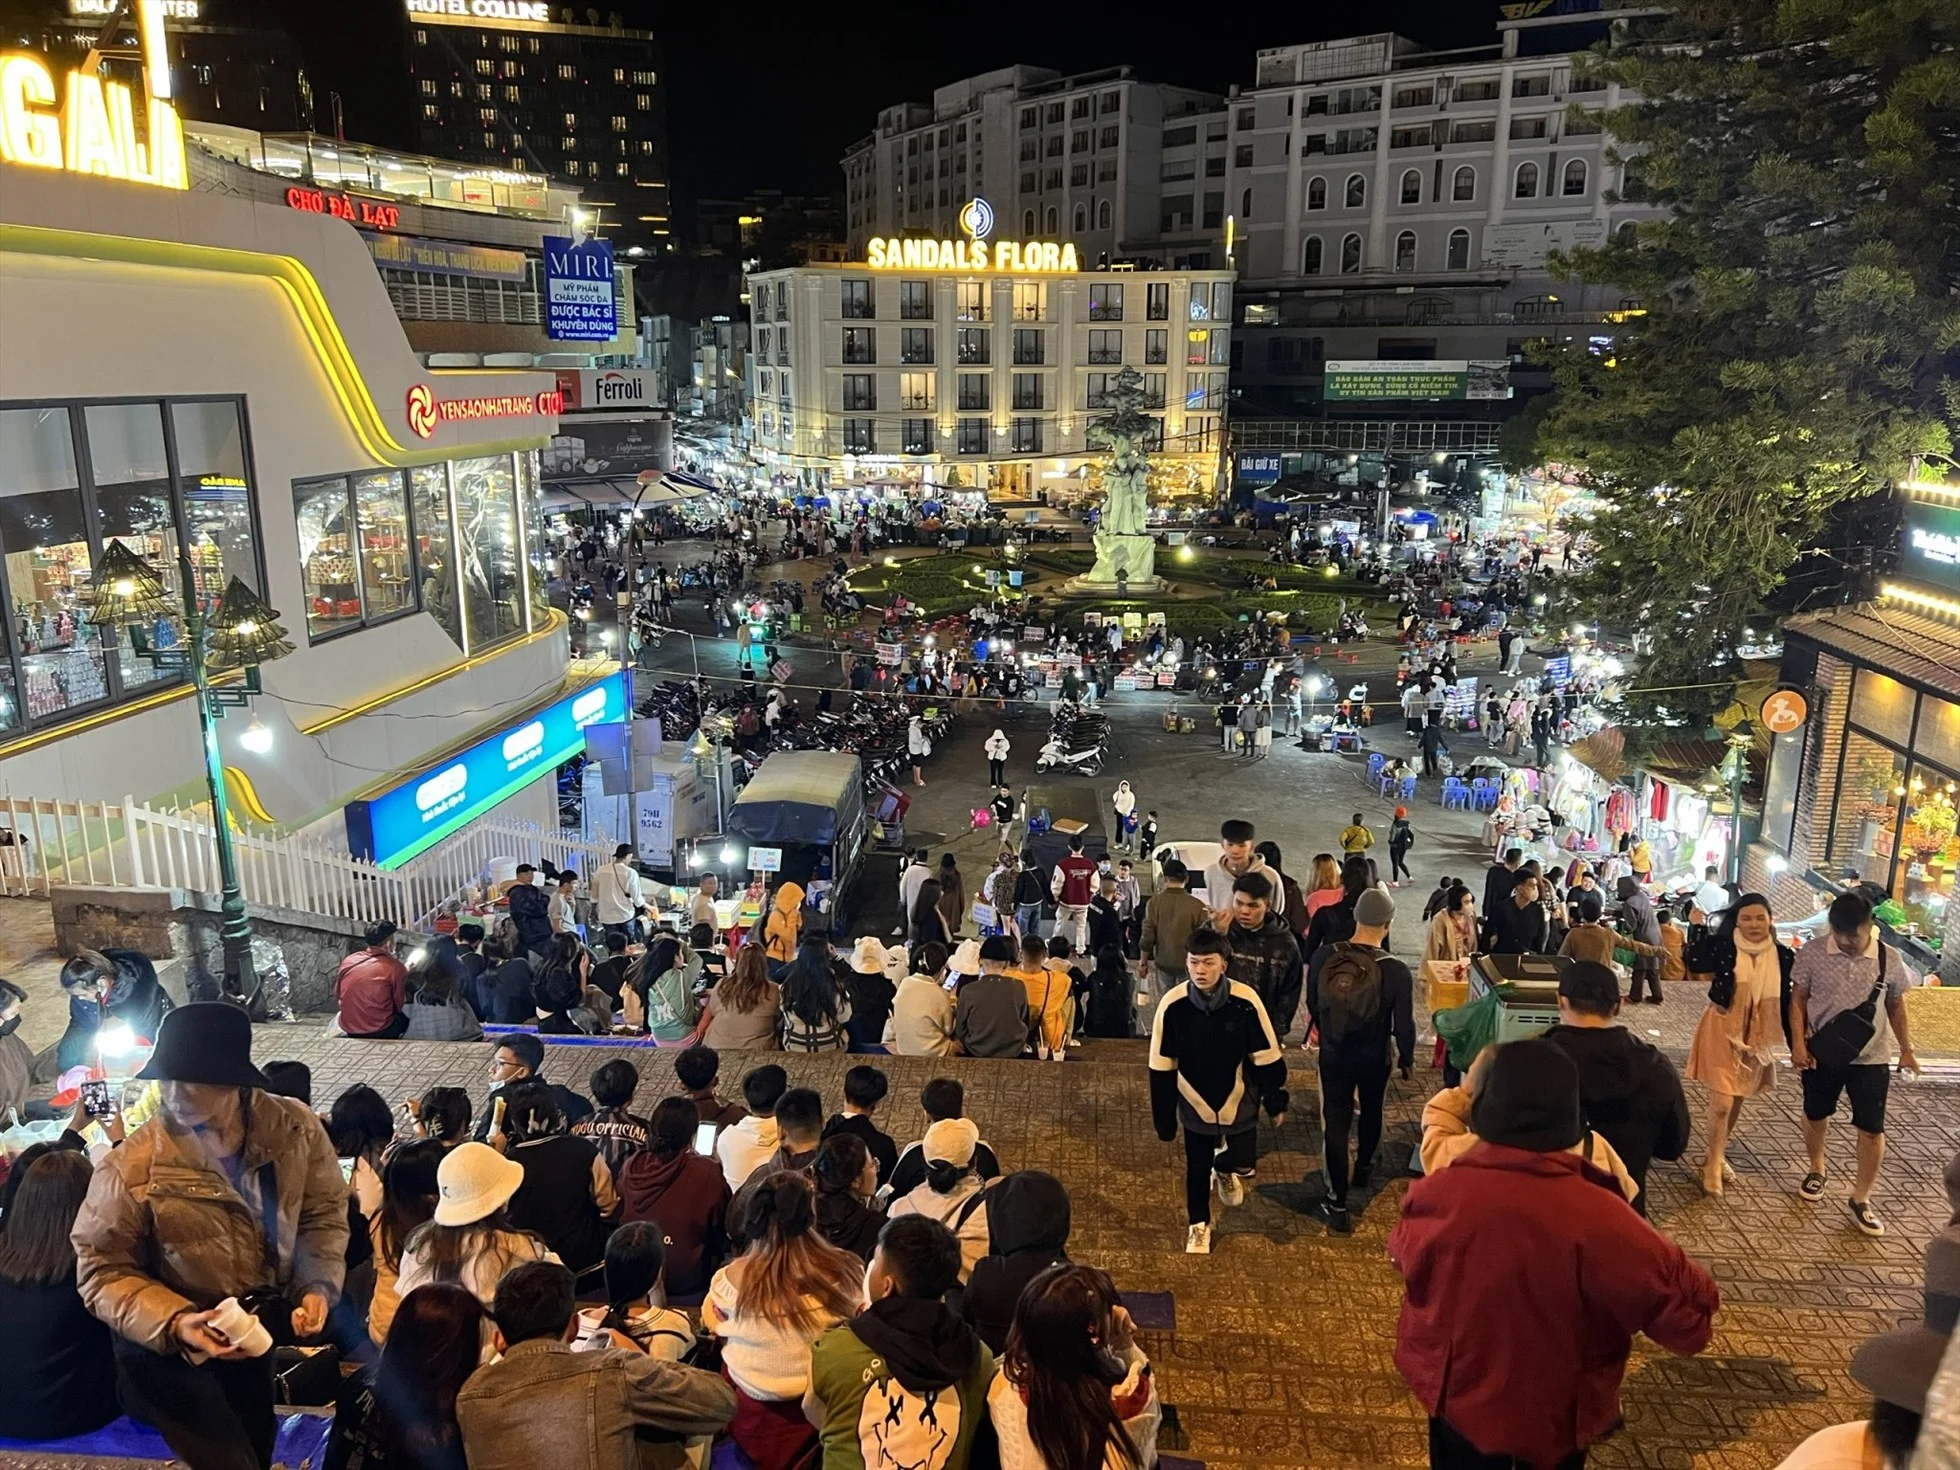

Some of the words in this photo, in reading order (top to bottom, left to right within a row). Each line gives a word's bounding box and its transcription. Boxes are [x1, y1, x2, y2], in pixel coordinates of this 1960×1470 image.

[407, 0, 469, 15] HOTEL
[472, 0, 549, 22] COLLINE
[328, 193, 357, 221] ĐÀ
[361, 202, 399, 231] LẠT
[550, 252, 609, 278] MIRI
[867, 237, 989, 269] SANDALS
[995, 240, 1079, 272] FLORA
[551, 305, 580, 319] ĐƯỢC
[582, 305, 601, 318] BÁC
[551, 318, 588, 330] KHUYÊN
[589, 319, 614, 331] DÙNG
[438, 396, 534, 421] YENSAONHATRANG
[1241, 456, 1254, 470] BÃI
[1255, 456, 1269, 470] GIỮ
[1269, 459, 1279, 470] XE
[640, 819, 663, 829] 9562
